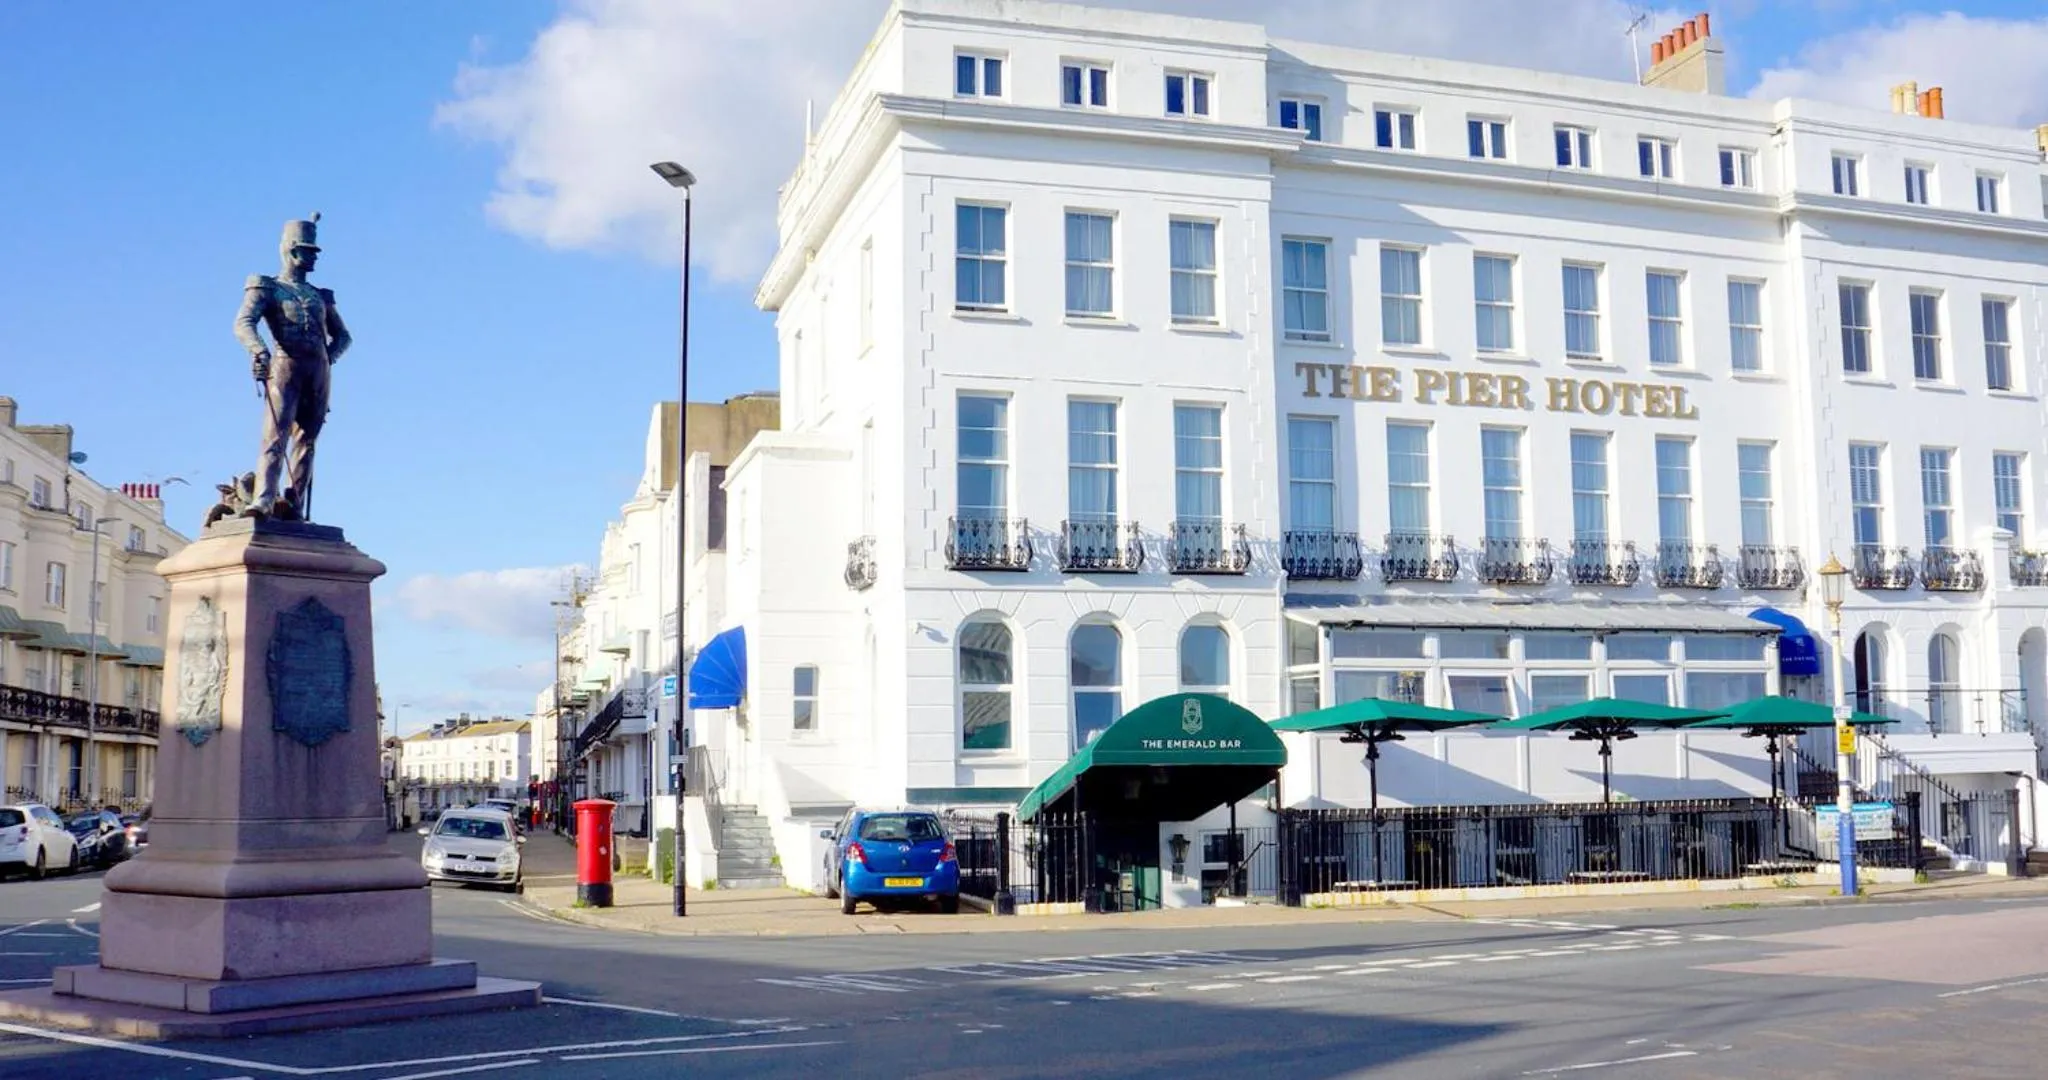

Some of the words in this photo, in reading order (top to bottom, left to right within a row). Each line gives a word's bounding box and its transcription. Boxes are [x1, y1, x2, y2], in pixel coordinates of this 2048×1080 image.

[1296, 362, 1398, 401] THE
[1413, 368, 1532, 410] PIER
[1545, 376, 1698, 420] HOTEL
[1142, 739, 1163, 749] THE
[1166, 739, 1217, 749] EMERALD
[1219, 739, 1242, 749] BAR
